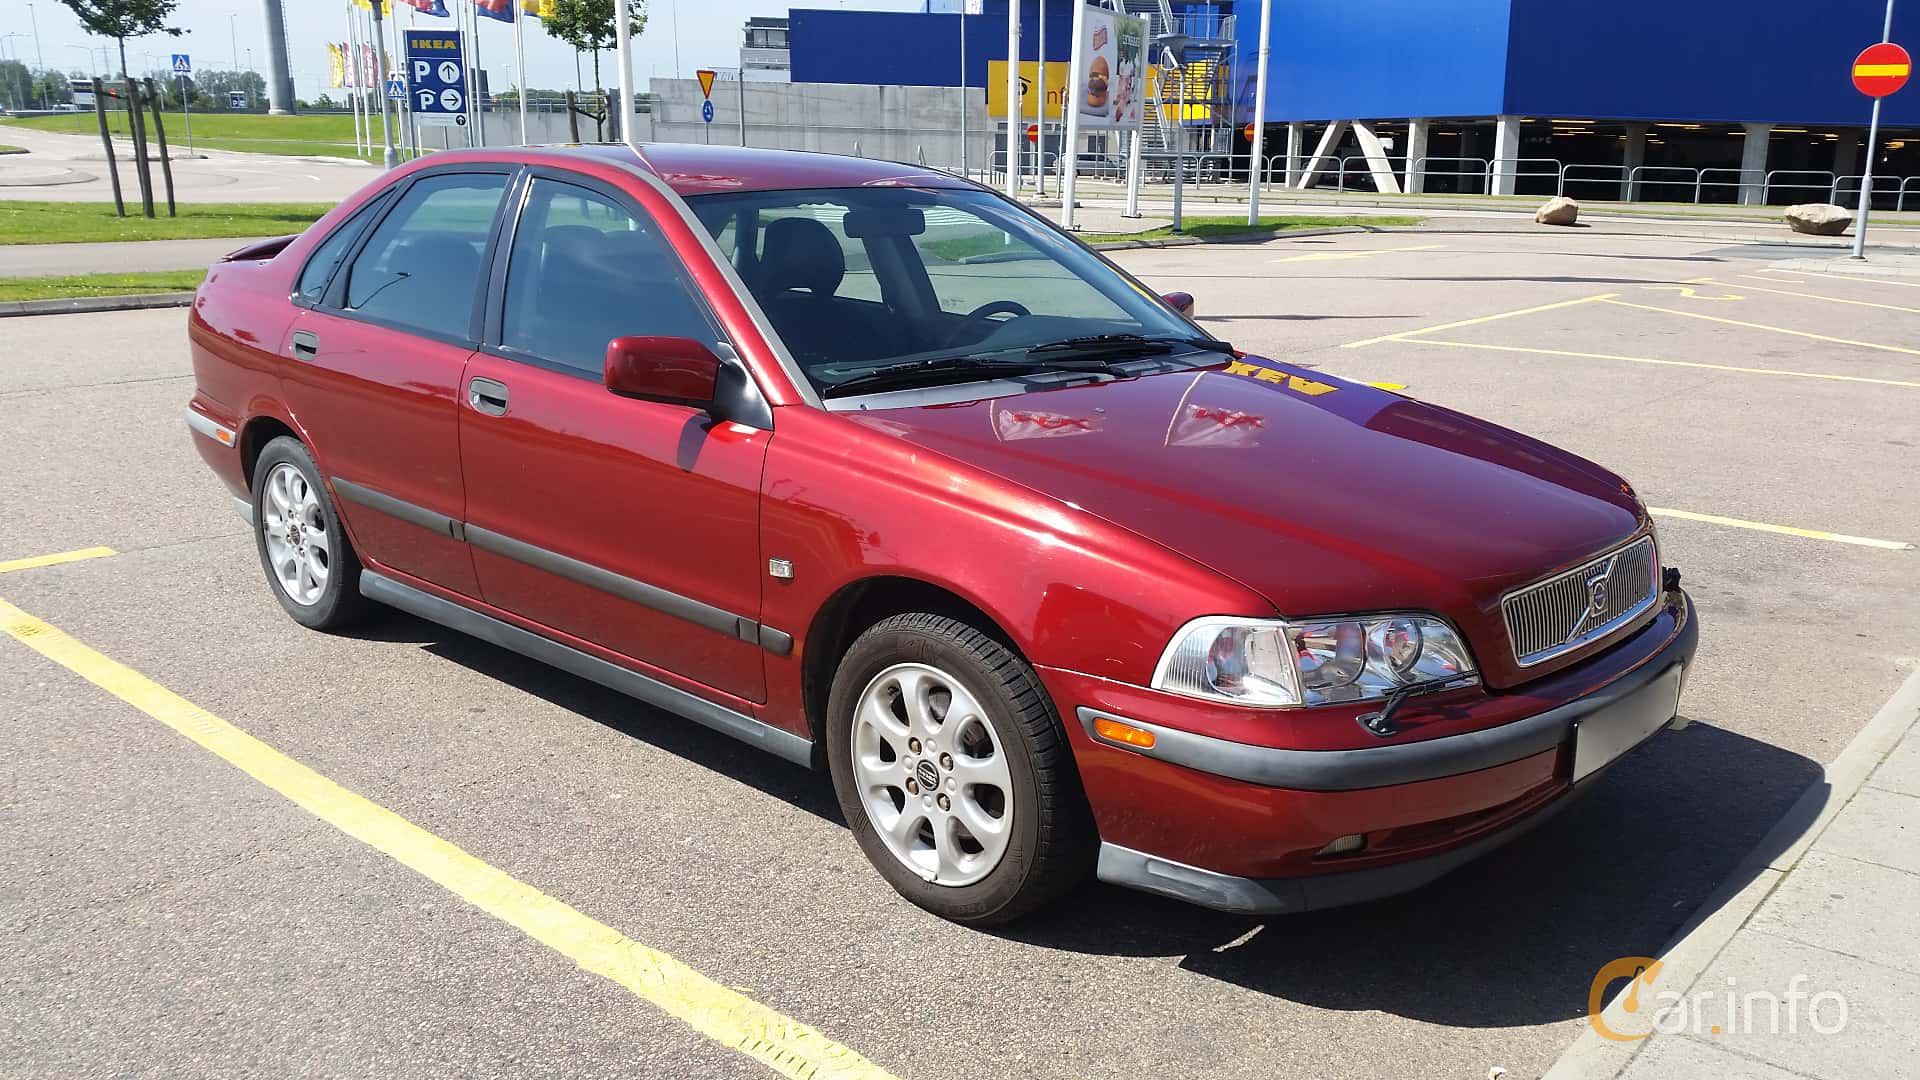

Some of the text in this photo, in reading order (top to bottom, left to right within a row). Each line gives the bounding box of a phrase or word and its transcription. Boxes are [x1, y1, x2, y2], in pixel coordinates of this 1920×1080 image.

[411, 39, 457, 50] IKEA
[414, 61, 431, 83] P
[420, 93, 435, 110] P
